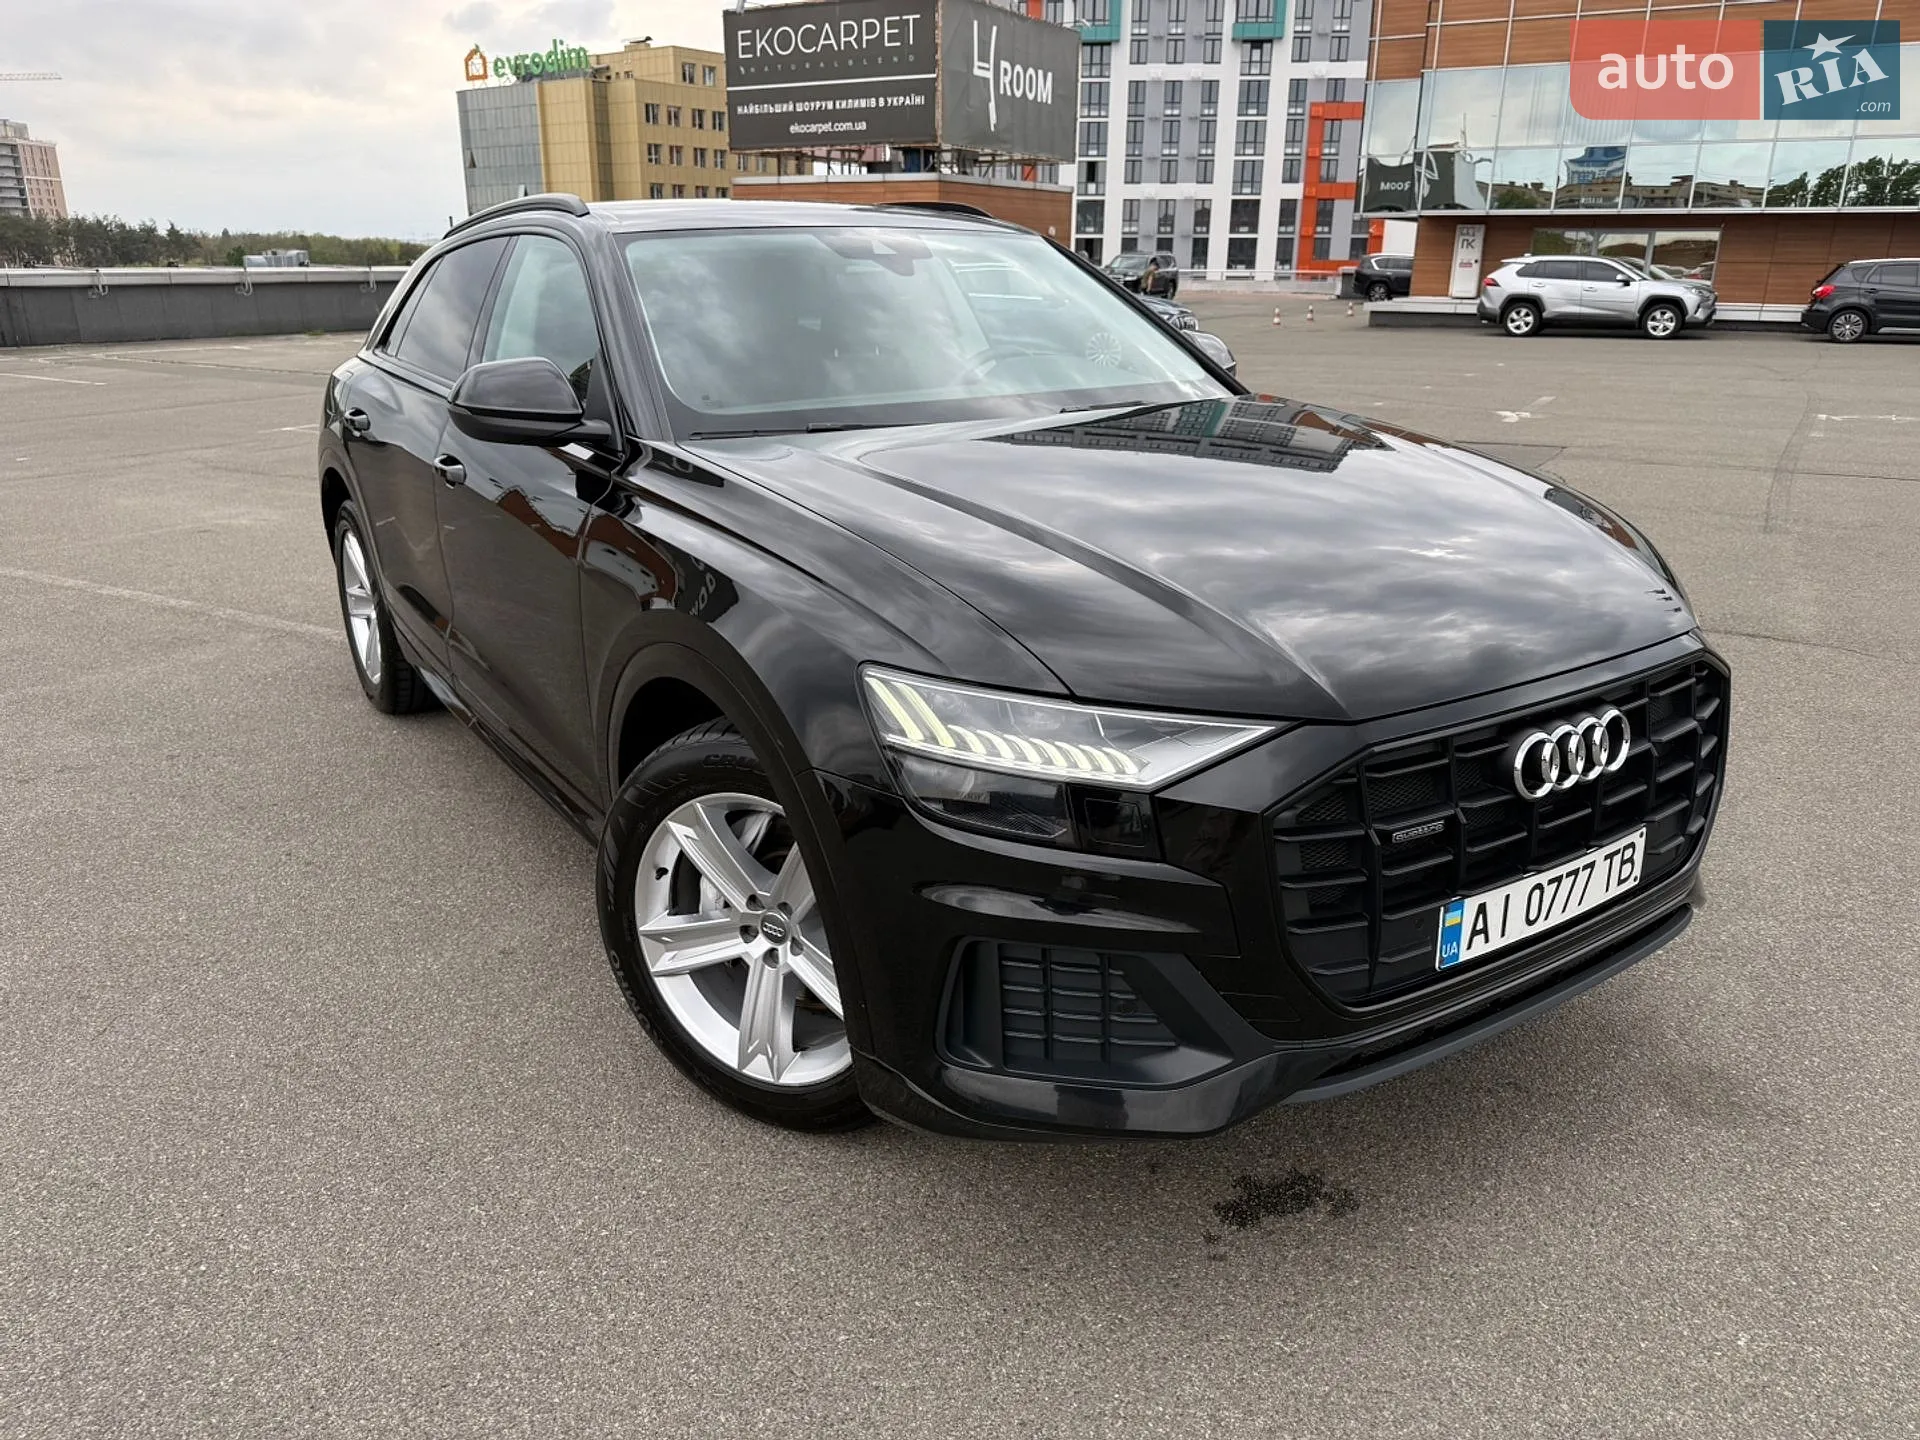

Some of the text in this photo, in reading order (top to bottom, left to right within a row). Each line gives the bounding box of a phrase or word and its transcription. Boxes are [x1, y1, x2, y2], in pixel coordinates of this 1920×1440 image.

[737, 14, 921, 59] EKOCARPET
[493, 38, 590, 78] evrodim
[1000, 59, 1053, 105] ROOM
[736, 101, 794, 115] НАЙБІЛЬШИЙ
[795, 99, 834, 112] ШОУРУМ
[835, 97, 877, 110] КИЛИМІВ
[886, 93, 925, 107] УКРАЇНІ
[789, 120, 867, 135] ekocarpet.com.ua
[1466, 841, 1636, 950] AI 0777 TB
[1442, 941, 1459, 958] UA
